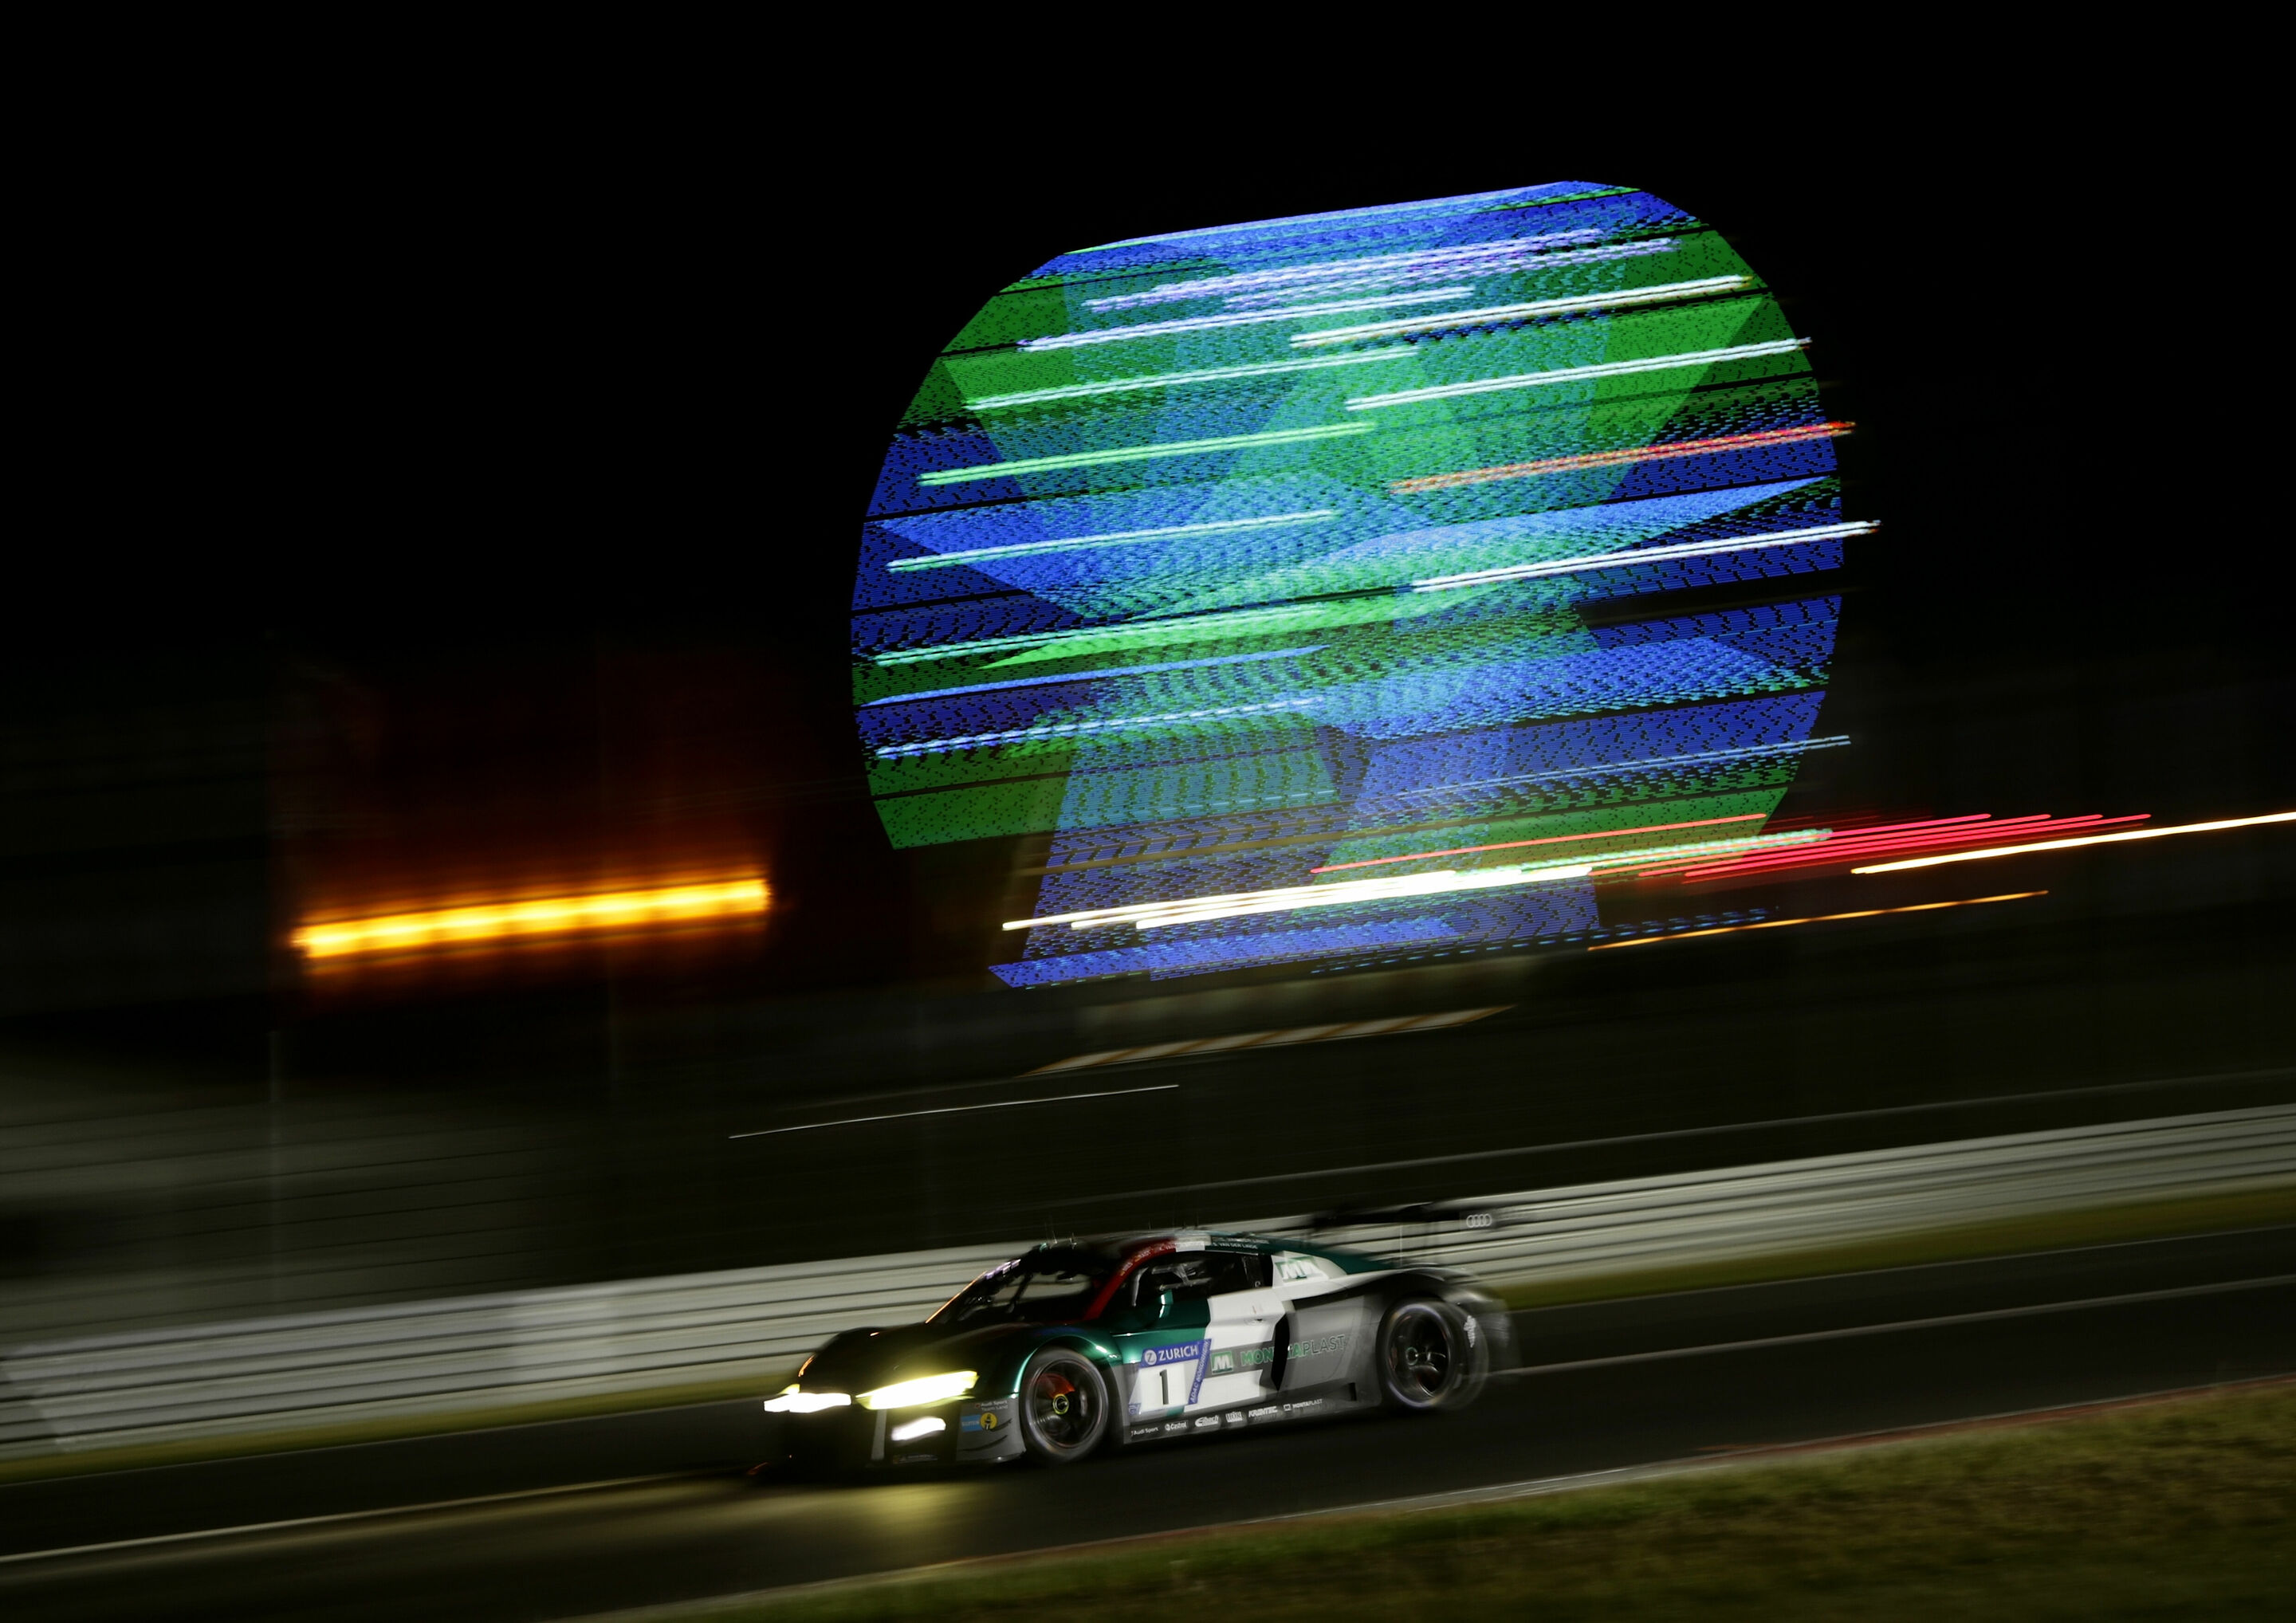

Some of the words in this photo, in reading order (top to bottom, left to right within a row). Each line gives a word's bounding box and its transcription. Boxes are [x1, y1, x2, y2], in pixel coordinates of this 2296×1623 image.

[1158, 1345, 1199, 1362] ZURICH
[1159, 1369, 1170, 1405] 1
[1189, 1382, 1199, 1404] ADAC
[1170, 1421, 1188, 1430] Castrol
